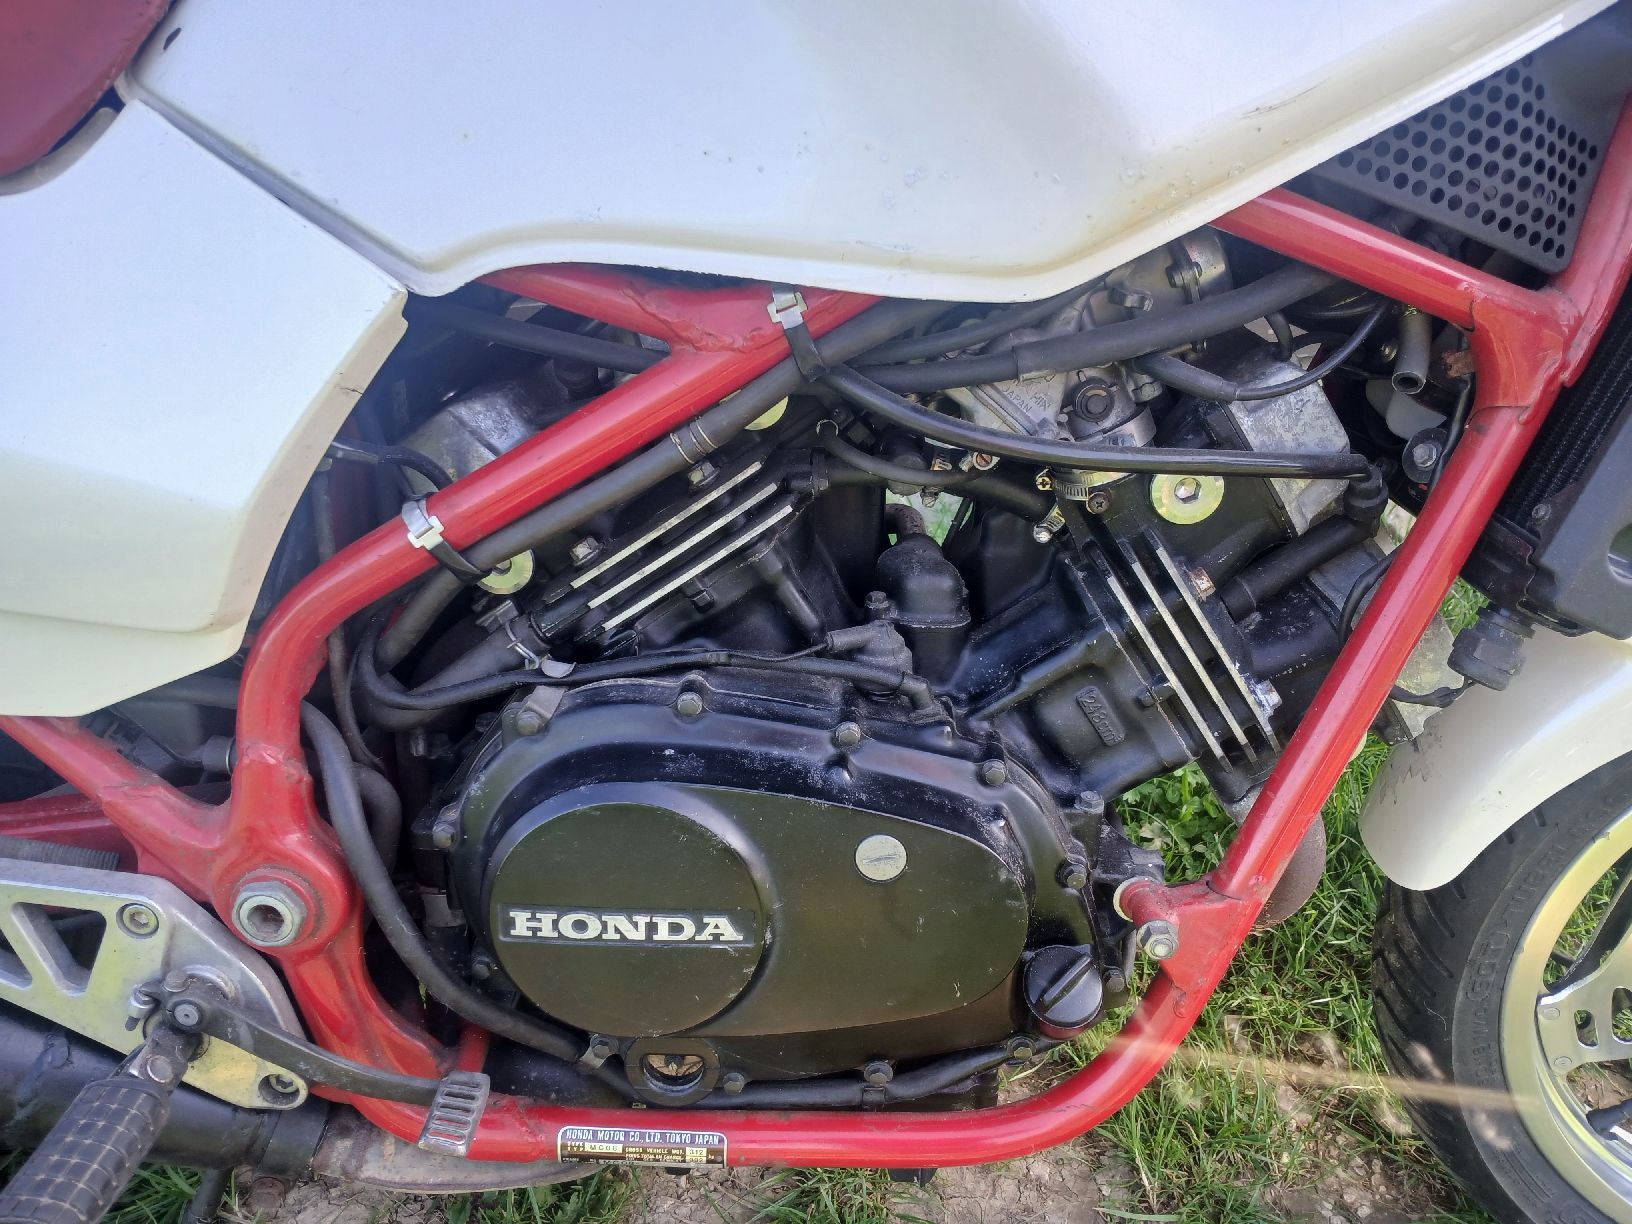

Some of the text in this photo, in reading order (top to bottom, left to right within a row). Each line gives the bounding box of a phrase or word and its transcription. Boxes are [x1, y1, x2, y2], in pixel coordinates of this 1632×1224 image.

[1002, 385, 1033, 413] JAPAN
[509, 911, 743, 941] HONDA
[566, 1128, 593, 1140] HONDA
[597, 1129, 625, 1141] MOTOR
[666, 1132, 691, 1144] TOKYO
[695, 1134, 719, 1145] JAPAN
